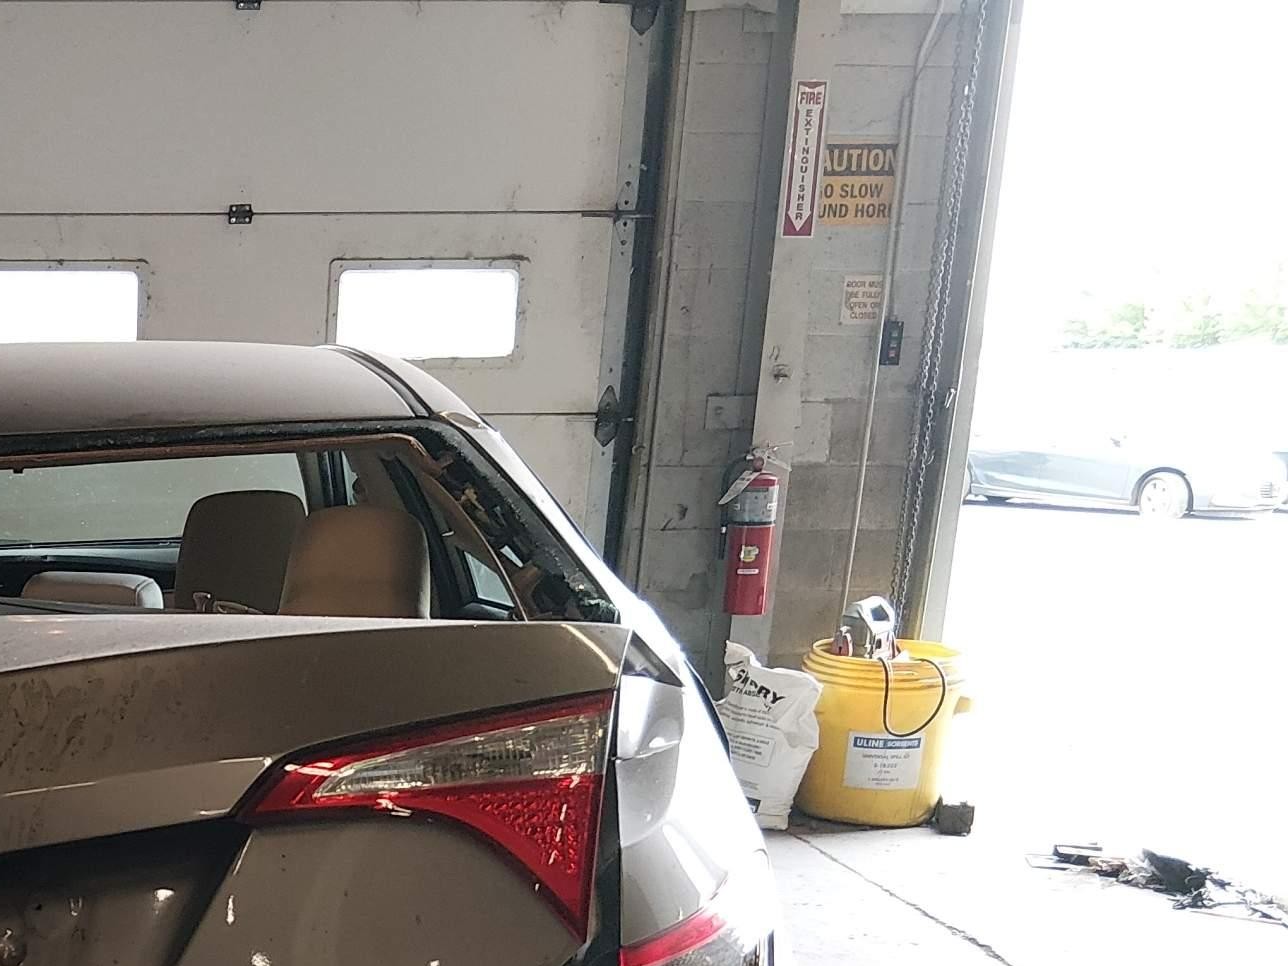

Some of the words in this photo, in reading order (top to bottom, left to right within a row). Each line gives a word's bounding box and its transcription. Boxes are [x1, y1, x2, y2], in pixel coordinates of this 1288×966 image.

[799, 91, 823, 106] FIRE
[795, 109, 813, 221] EXTINGUISHER
[823, 148, 895, 172] AUTION
[819, 183, 834, 199] O
[839, 183, 884, 199] SLOW
[817, 203, 849, 219] UND
[856, 738, 884, 748] ULINE
